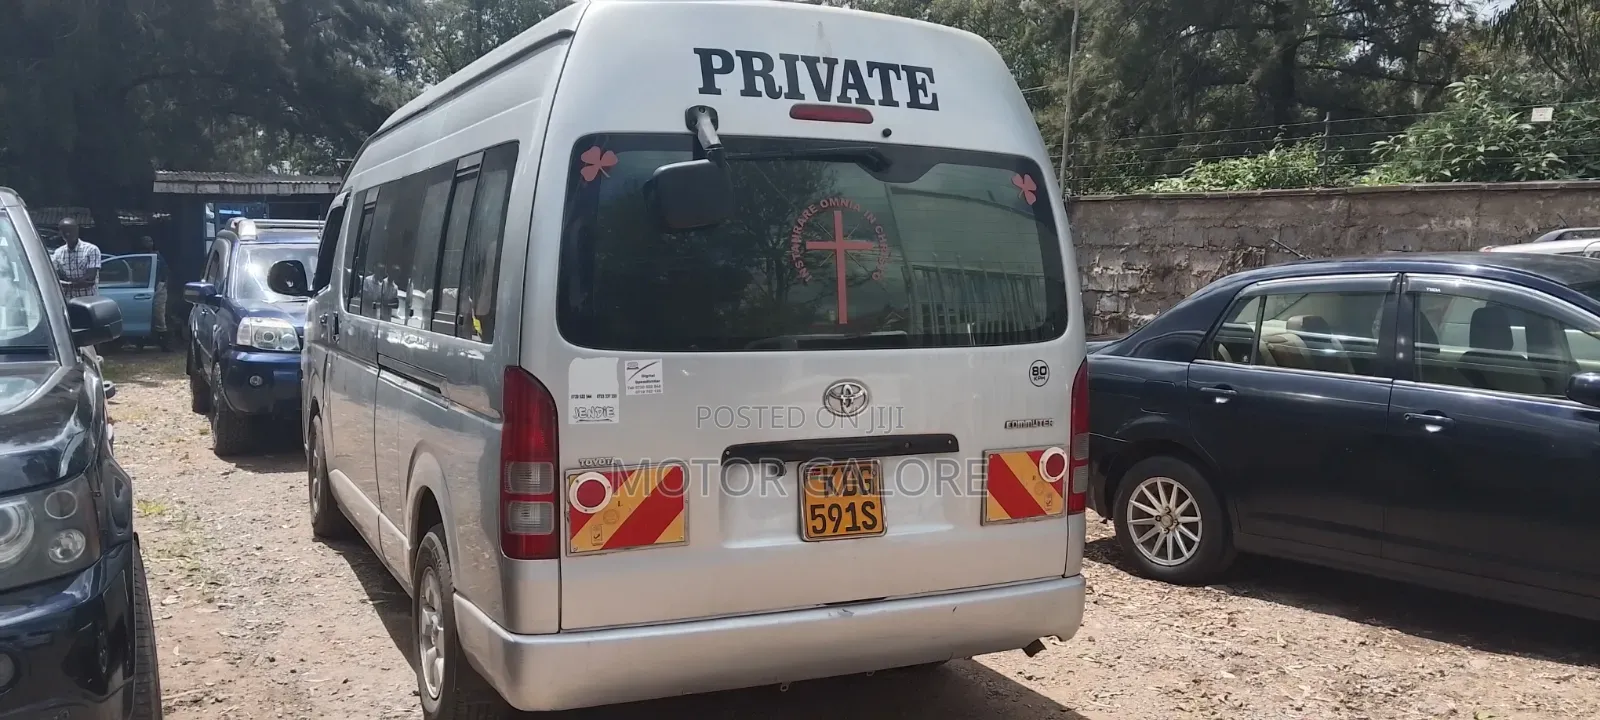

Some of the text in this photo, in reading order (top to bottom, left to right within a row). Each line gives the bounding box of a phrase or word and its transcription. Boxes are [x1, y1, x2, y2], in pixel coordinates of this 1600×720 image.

[693, 47, 940, 111] PRIVATE
[790, 204, 819, 282] INSTAURARE
[820, 197, 861, 212] OMNIA
[864, 210, 877, 224] IN
[1032, 366, 1047, 376] 80
[578, 456, 616, 467] TOYOTA
[810, 501, 878, 534] 591S
